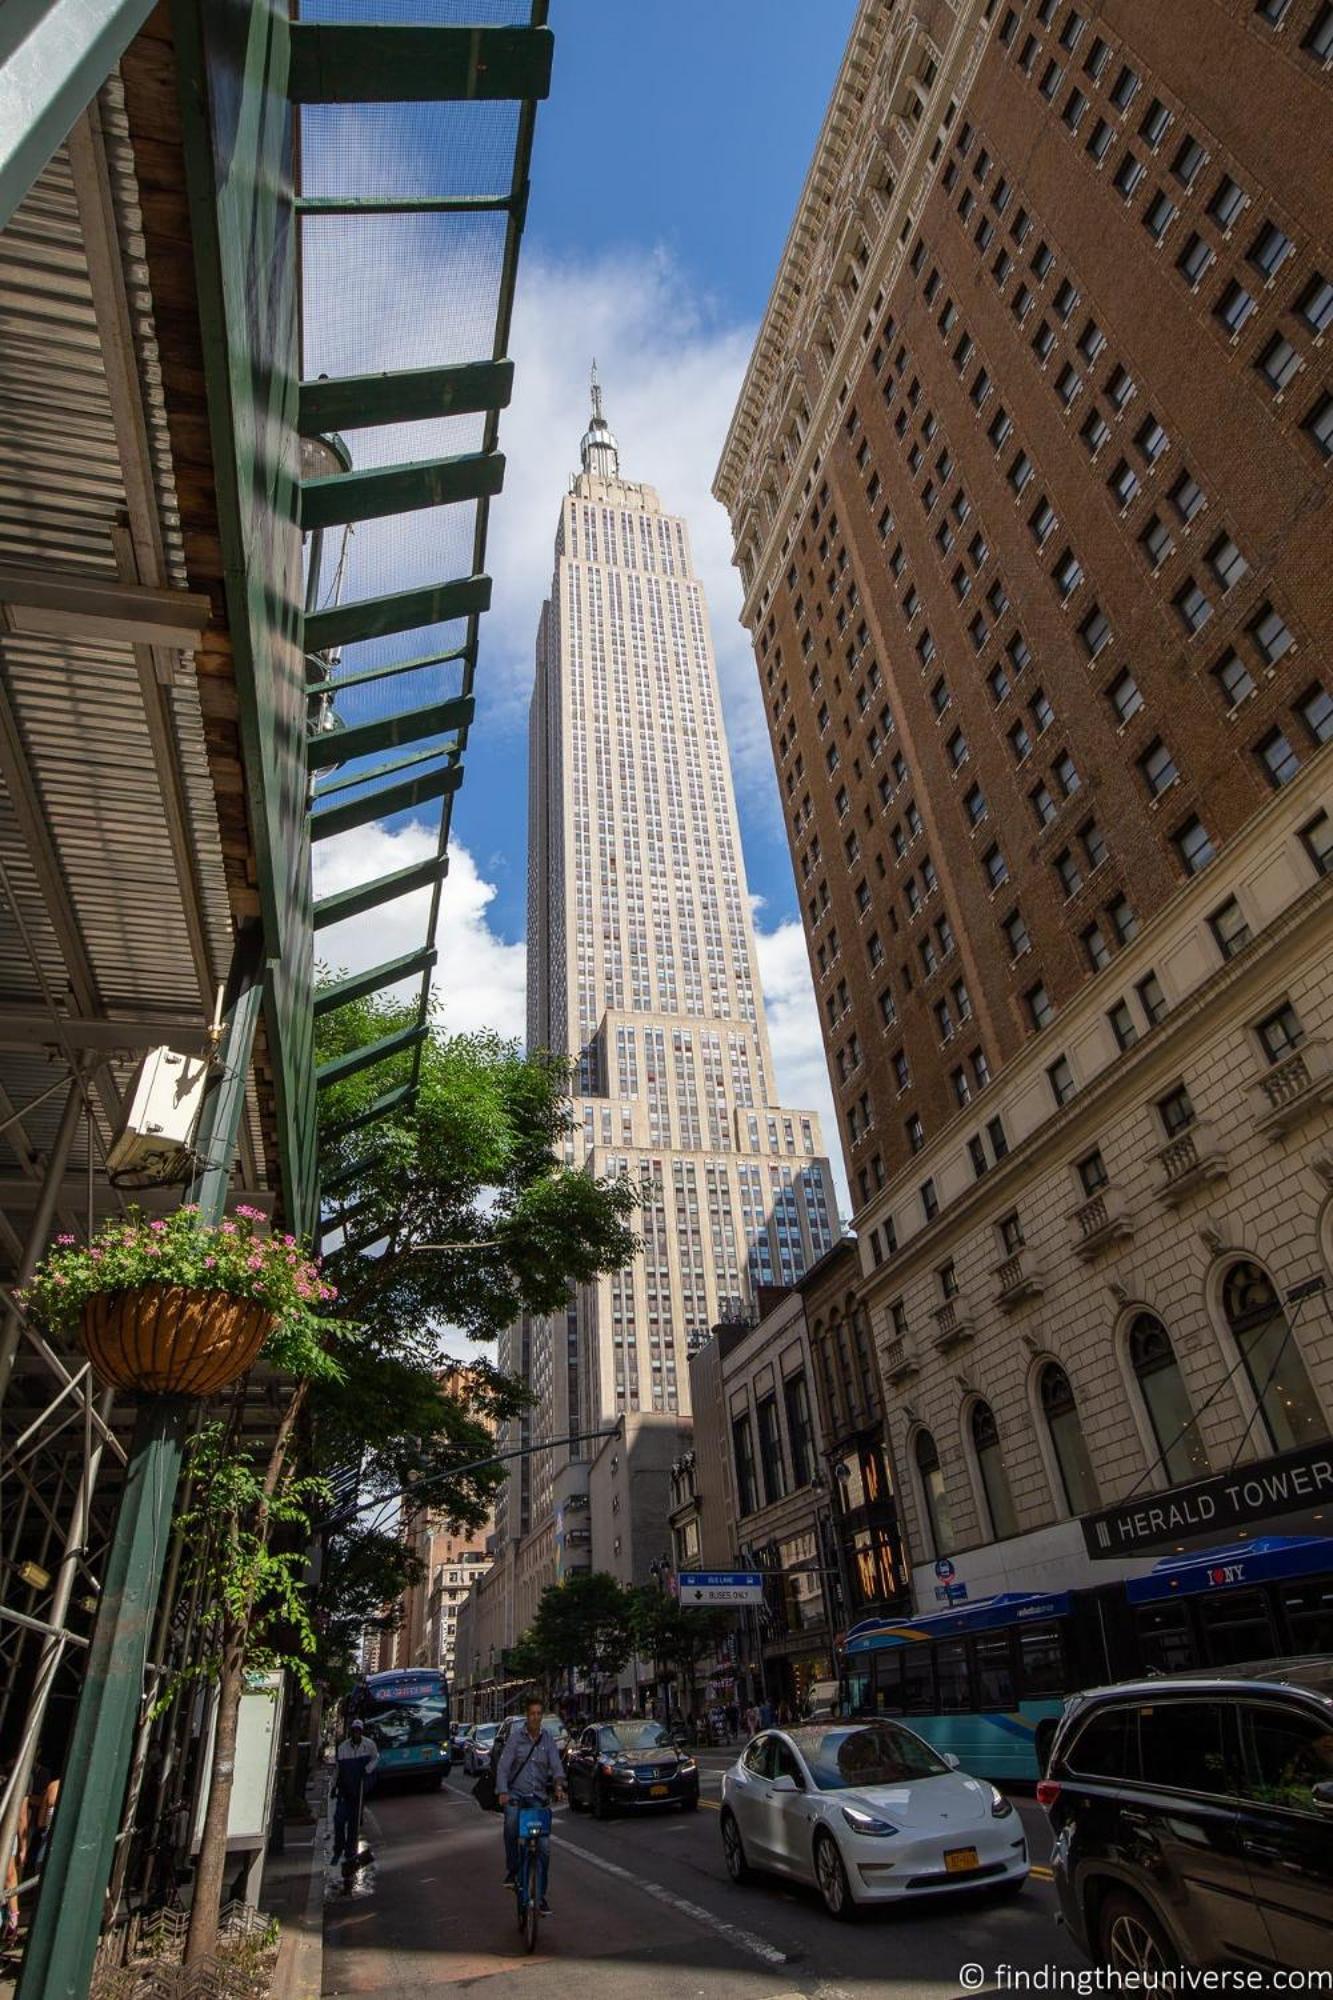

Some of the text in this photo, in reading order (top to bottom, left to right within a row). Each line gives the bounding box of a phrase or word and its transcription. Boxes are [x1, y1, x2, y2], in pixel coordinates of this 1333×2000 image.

[1117, 1461, 1333, 1541] HERALD TOWER
[708, 1591, 749, 1600] BUSES ONLY
